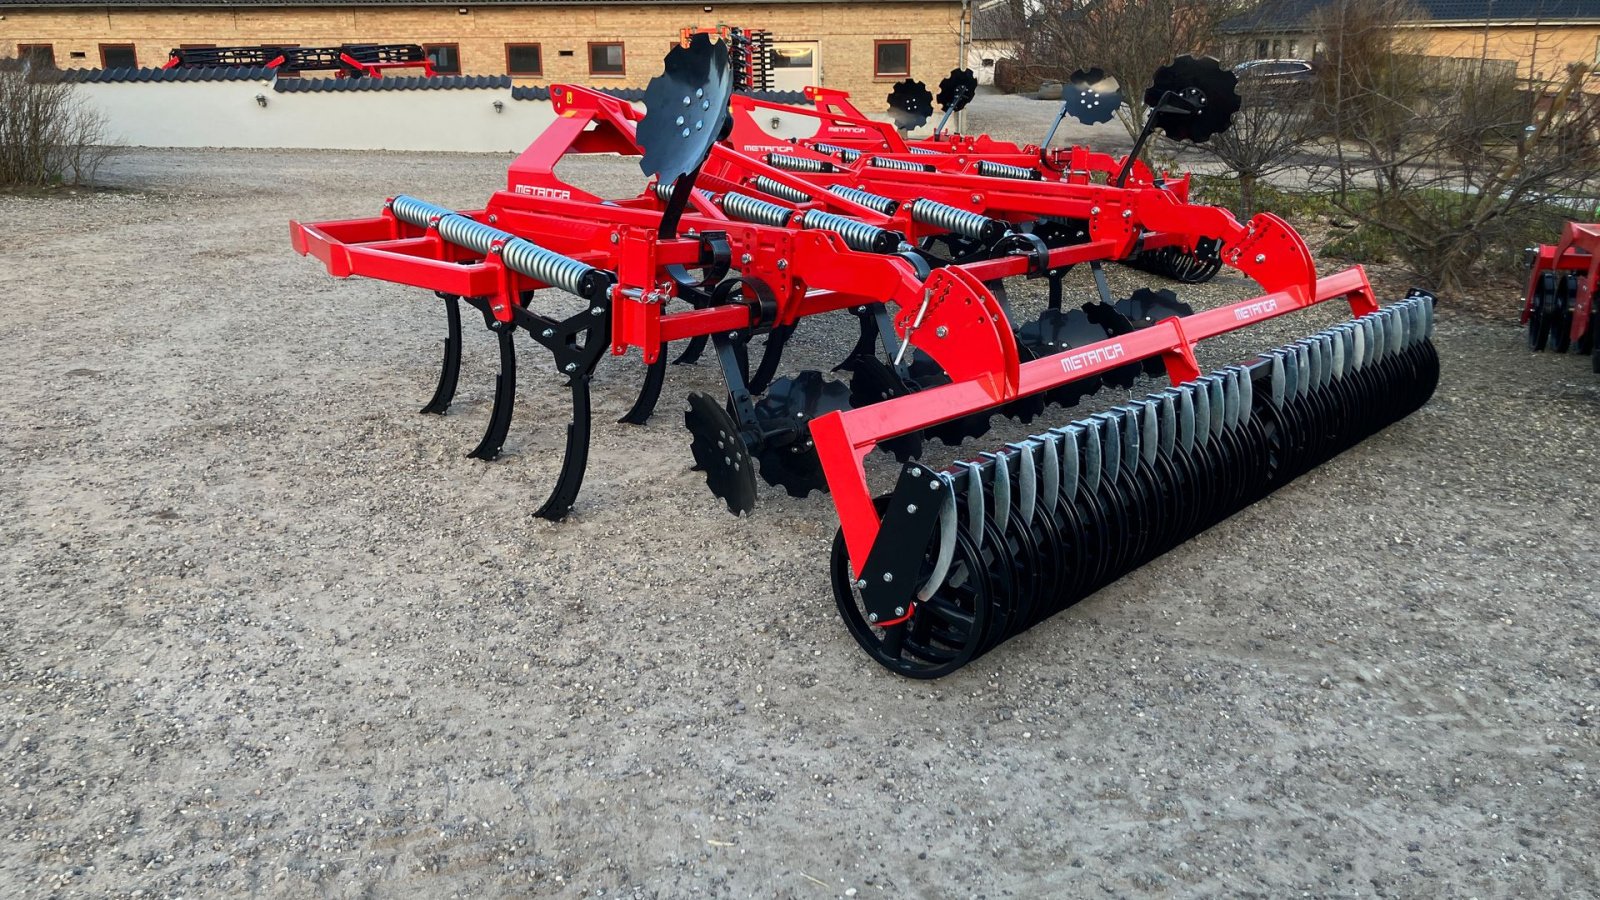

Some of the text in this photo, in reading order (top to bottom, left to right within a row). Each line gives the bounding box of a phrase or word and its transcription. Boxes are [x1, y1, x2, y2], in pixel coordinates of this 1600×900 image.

[743, 145, 794, 153] METANGA
[515, 184, 571, 200] METANGA
[1233, 298, 1278, 321] METANGA
[1060, 342, 1125, 373] METANGA
